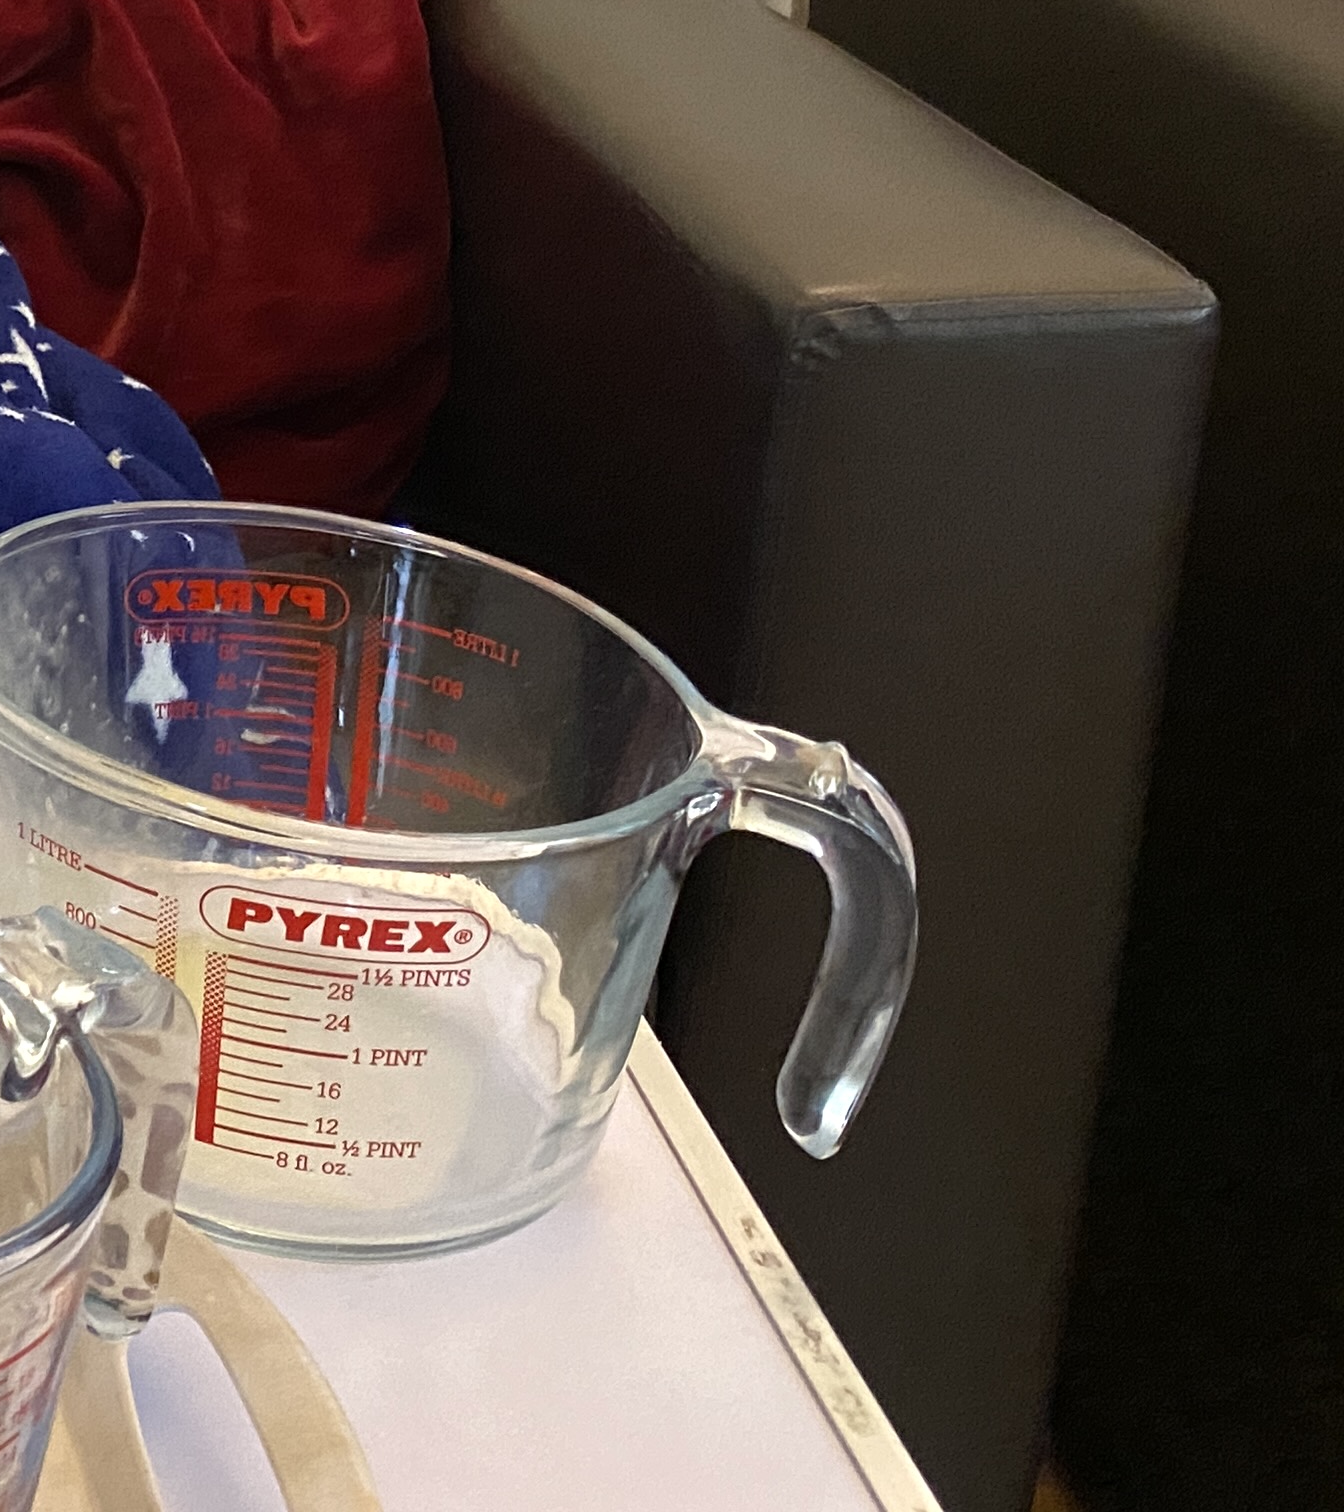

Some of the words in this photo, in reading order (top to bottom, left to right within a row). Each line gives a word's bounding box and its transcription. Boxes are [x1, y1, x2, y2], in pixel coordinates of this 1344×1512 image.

[18, 822, 25, 839] 1
[30, 828, 82, 871] LITRE
[400, 968, 471, 987] PINTS
[327, 984, 354, 1002] 28
[324, 1014, 351, 1032] 24
[353, 1048, 361, 1065] 1
[370, 1049, 427, 1067] PINT
[317, 1082, 341, 1099] 16
[314, 1118, 339, 1135] 12
[366, 1141, 421, 1158] PINT
[276, 1151, 288, 1168] 8
[322, 1161, 352, 1176] oz.
